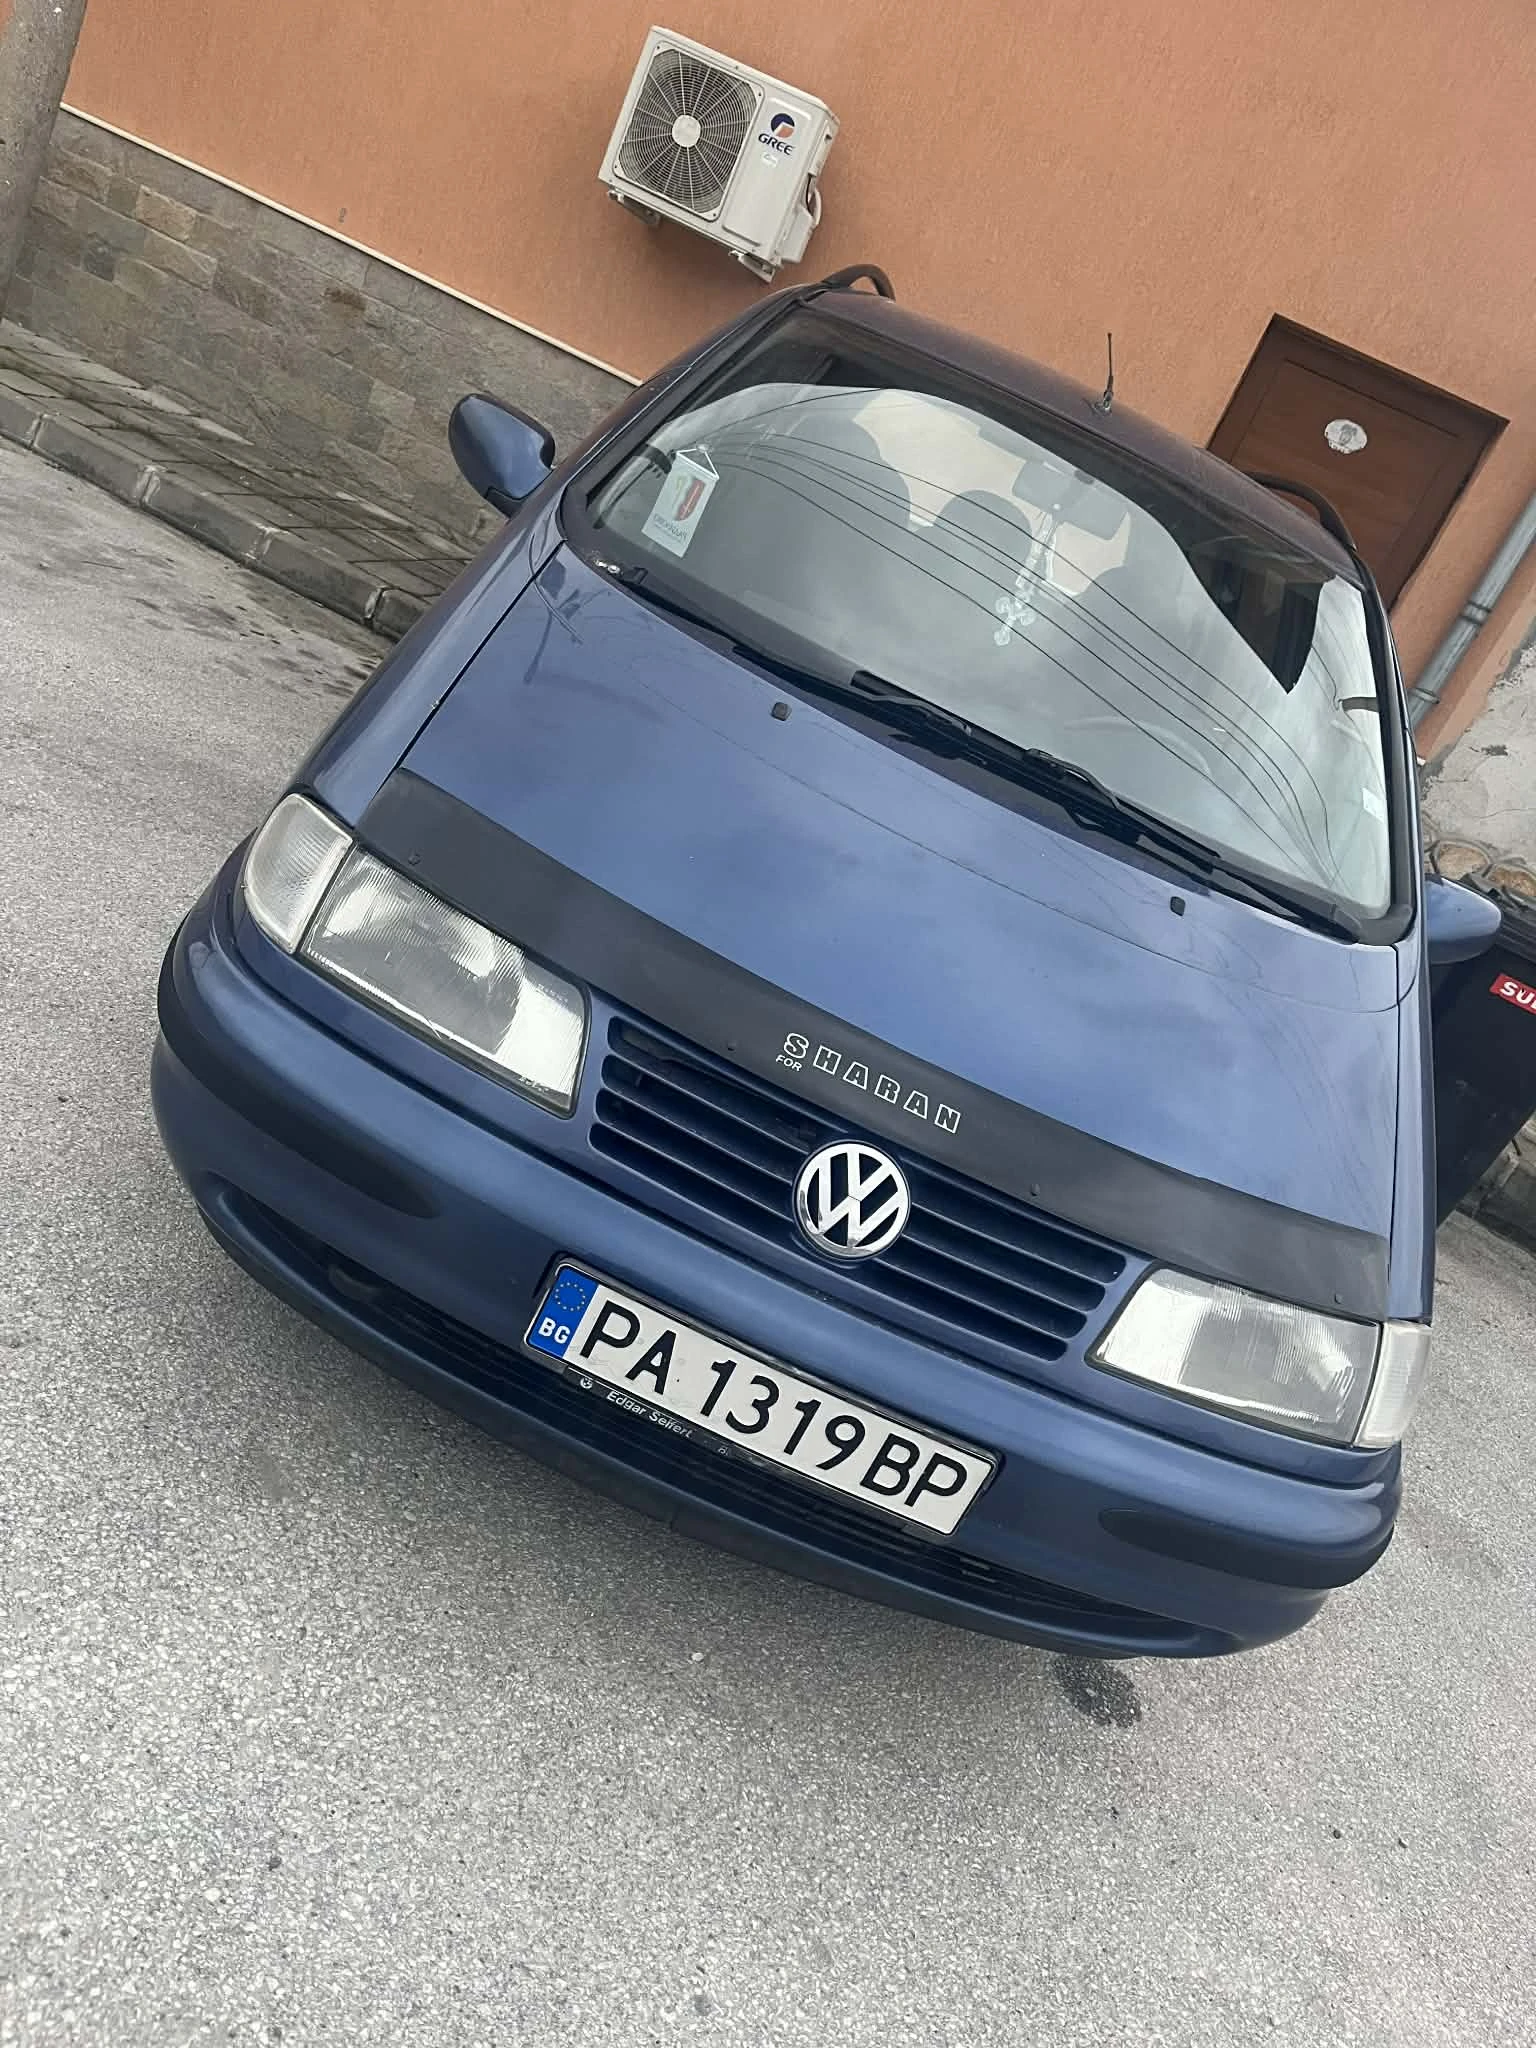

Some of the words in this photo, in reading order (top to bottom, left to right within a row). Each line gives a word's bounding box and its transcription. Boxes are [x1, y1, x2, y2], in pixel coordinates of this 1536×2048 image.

[758, 133, 793, 155] GREE
[776, 1054, 802, 1072] FOR
[783, 1032, 961, 1134] SHARAN
[538, 1316, 571, 1345] BG
[579, 1299, 677, 1395] PA
[606, 1391, 646, 1416] Edgar
[649, 1411, 694, 1439] Seifert
